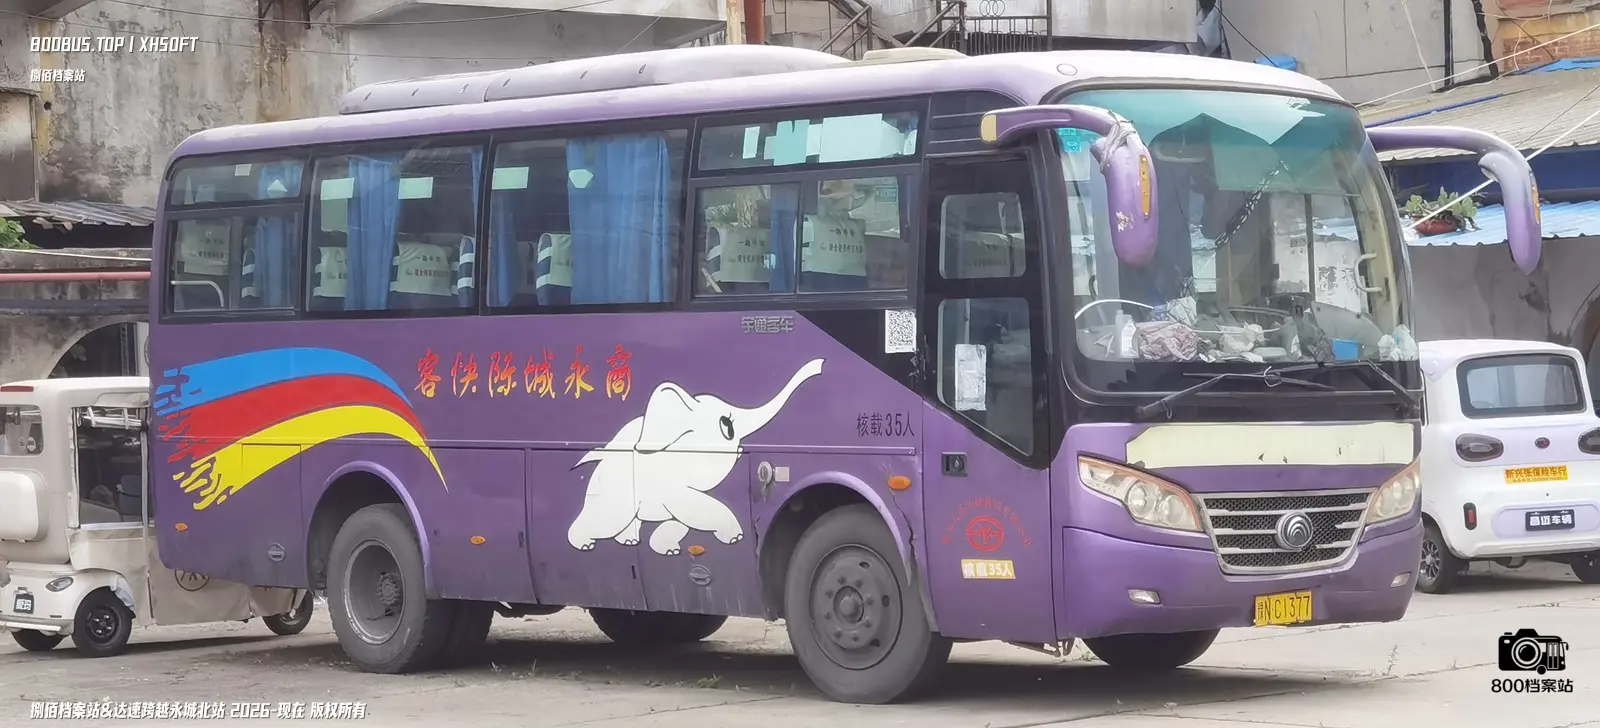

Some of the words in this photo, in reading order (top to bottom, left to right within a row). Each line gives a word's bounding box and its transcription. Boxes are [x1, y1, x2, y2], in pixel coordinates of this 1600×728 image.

[740, 315, 795, 335] 宇通客车
[856, 411, 915, 437] 核载35人
